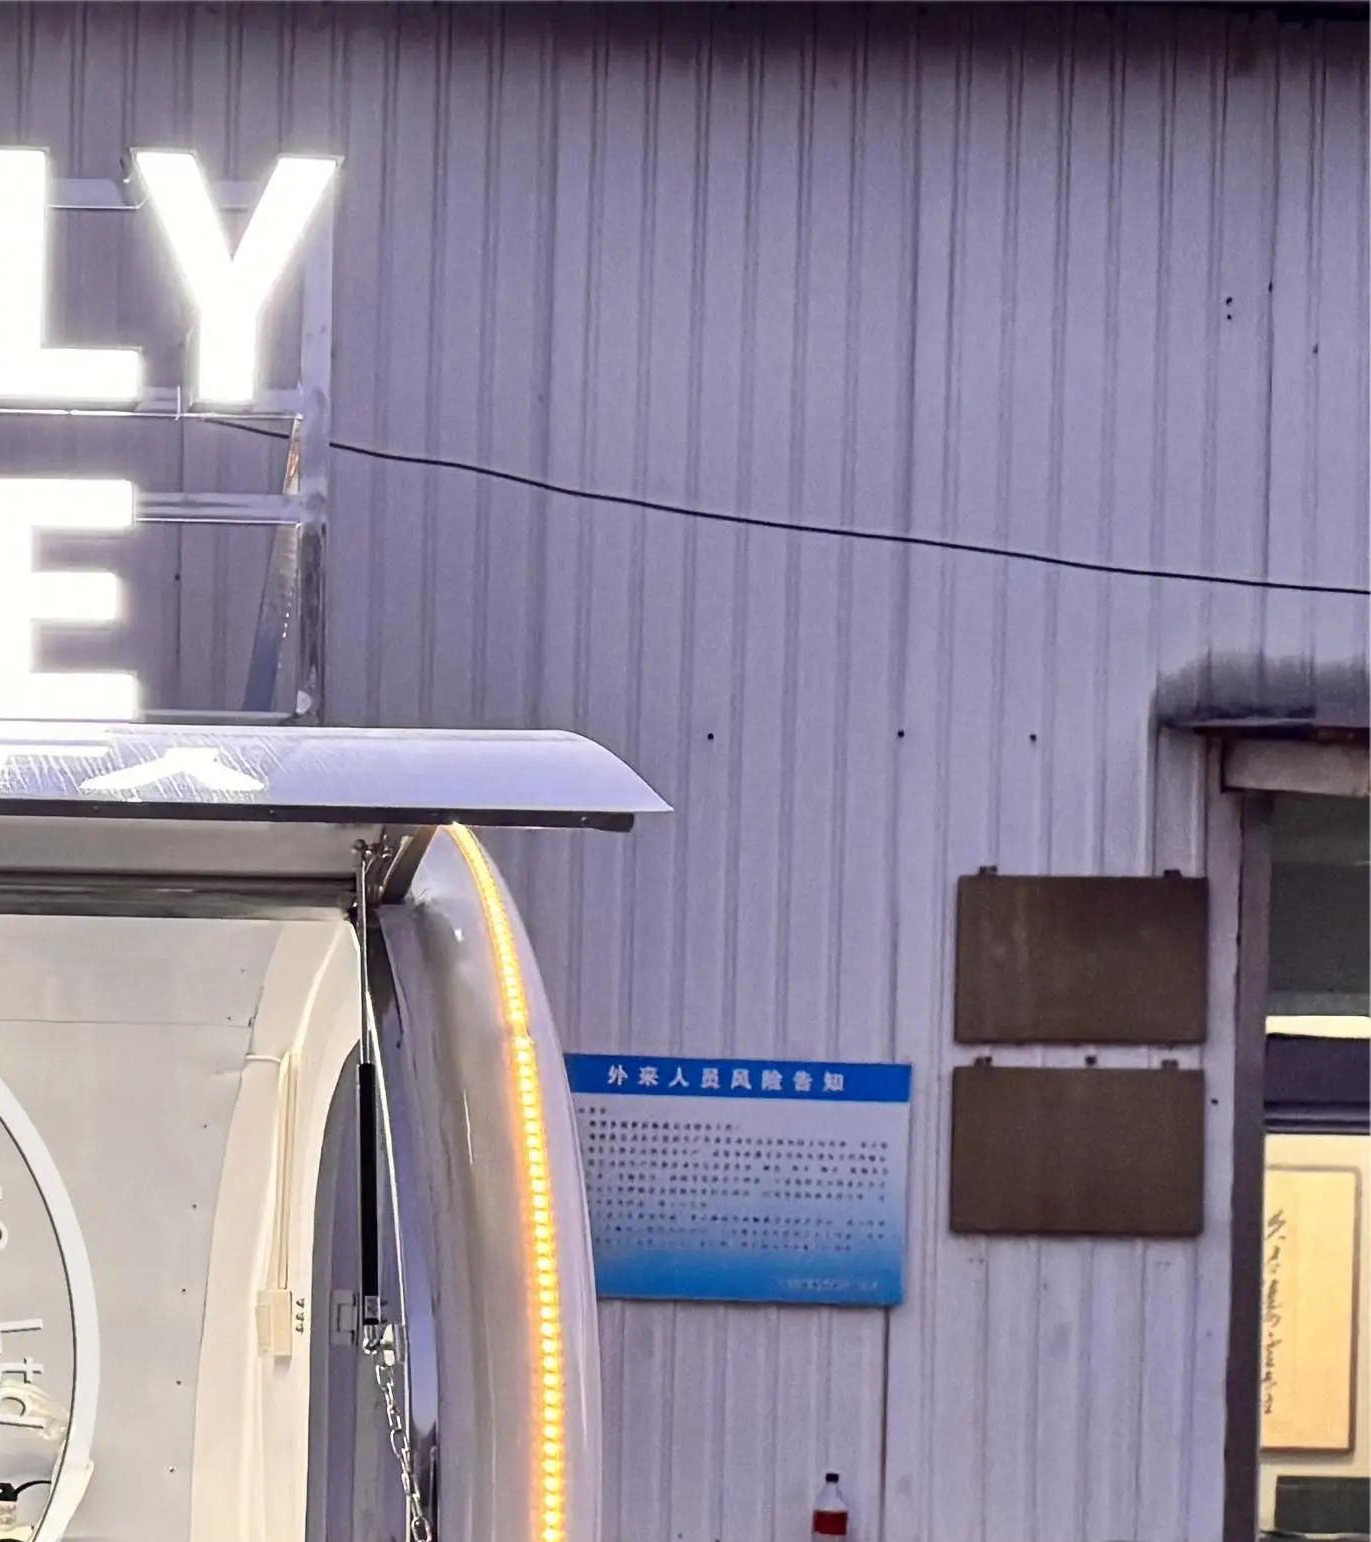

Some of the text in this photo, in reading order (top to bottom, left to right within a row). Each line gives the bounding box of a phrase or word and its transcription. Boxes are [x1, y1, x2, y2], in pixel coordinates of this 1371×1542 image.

[607, 1064, 845, 1092] 外来人员风险告知
